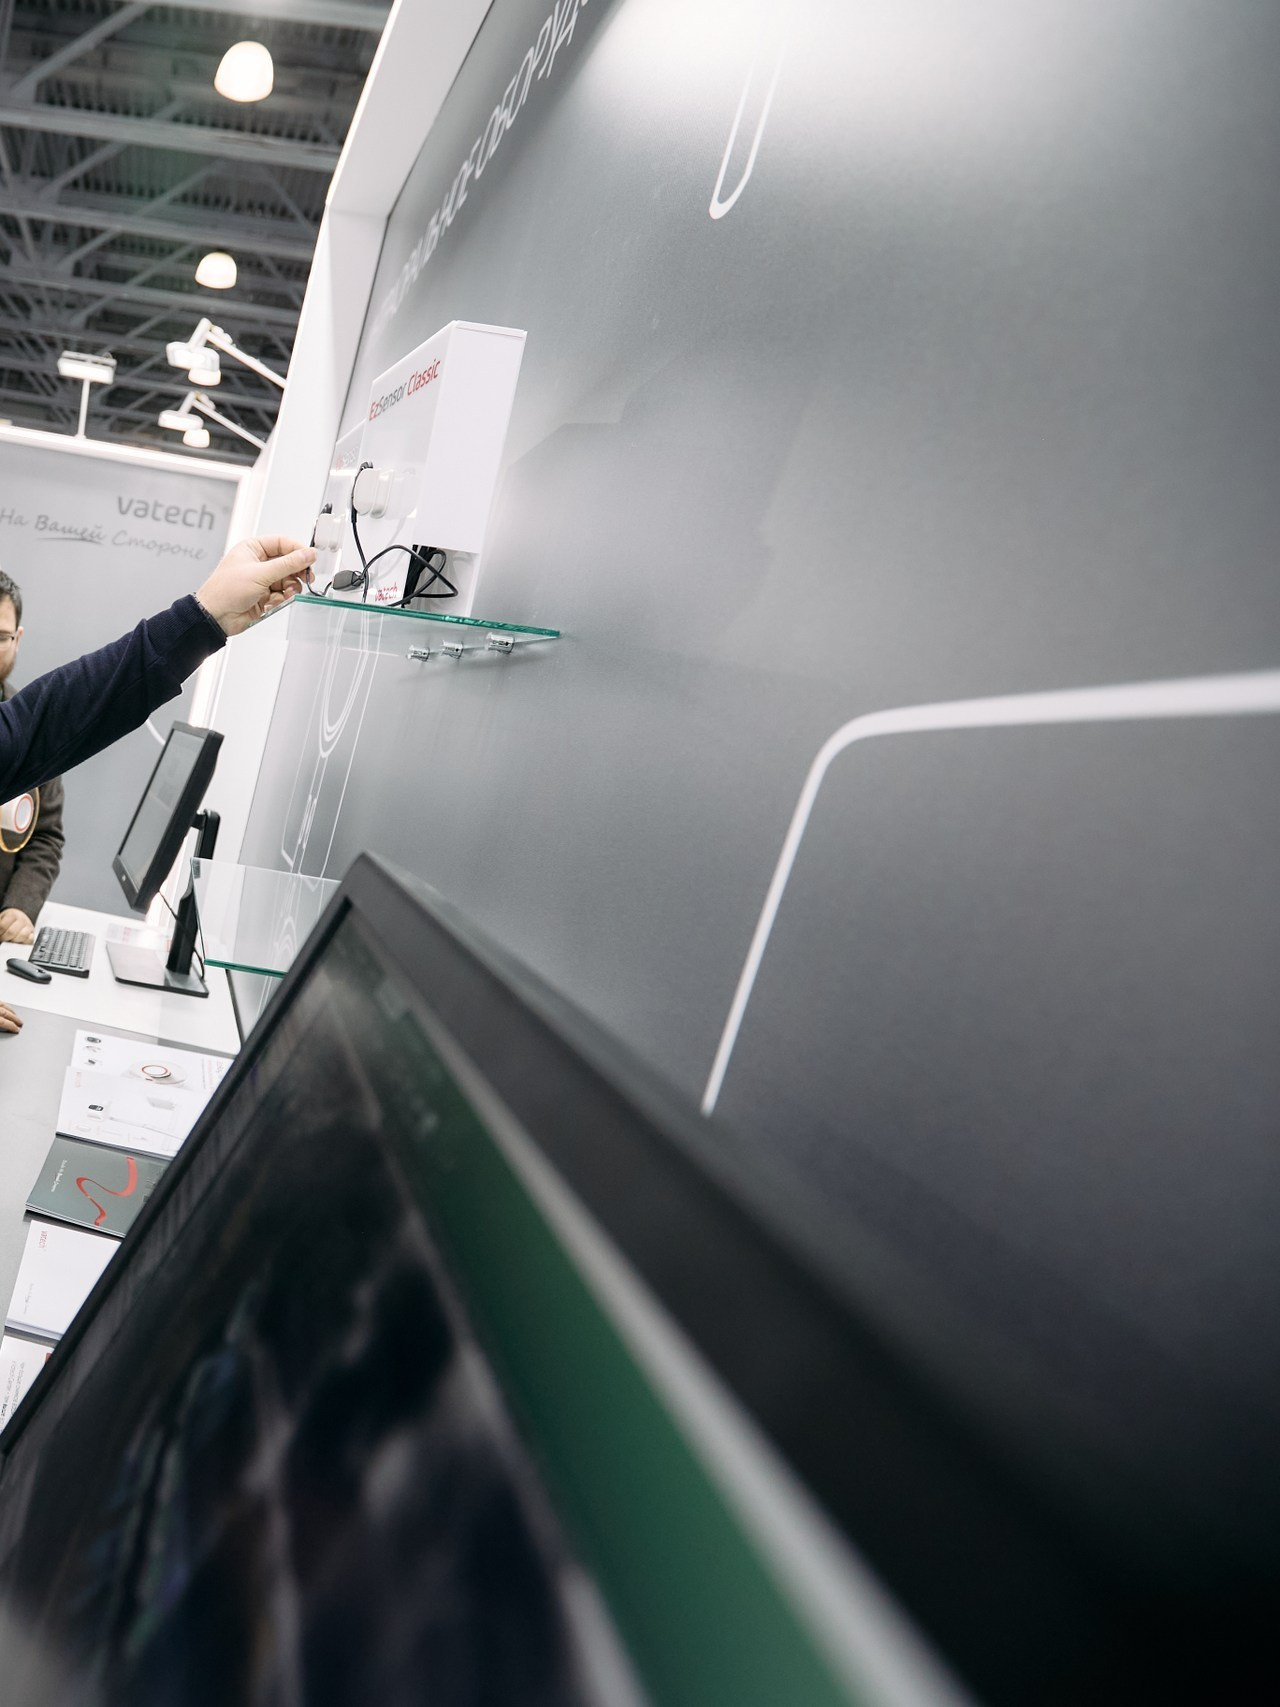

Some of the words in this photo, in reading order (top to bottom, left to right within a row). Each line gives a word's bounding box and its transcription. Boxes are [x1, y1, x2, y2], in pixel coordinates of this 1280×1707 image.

[475, 0, 589, 180] ОБОРУД
[369, 382, 407, 422] EzSensor
[407, 358, 441, 396] Classic
[34, 514, 106, 542] Вашей
[111, 530, 208, 562] Стороне
[117, 496, 216, 531] vatech
